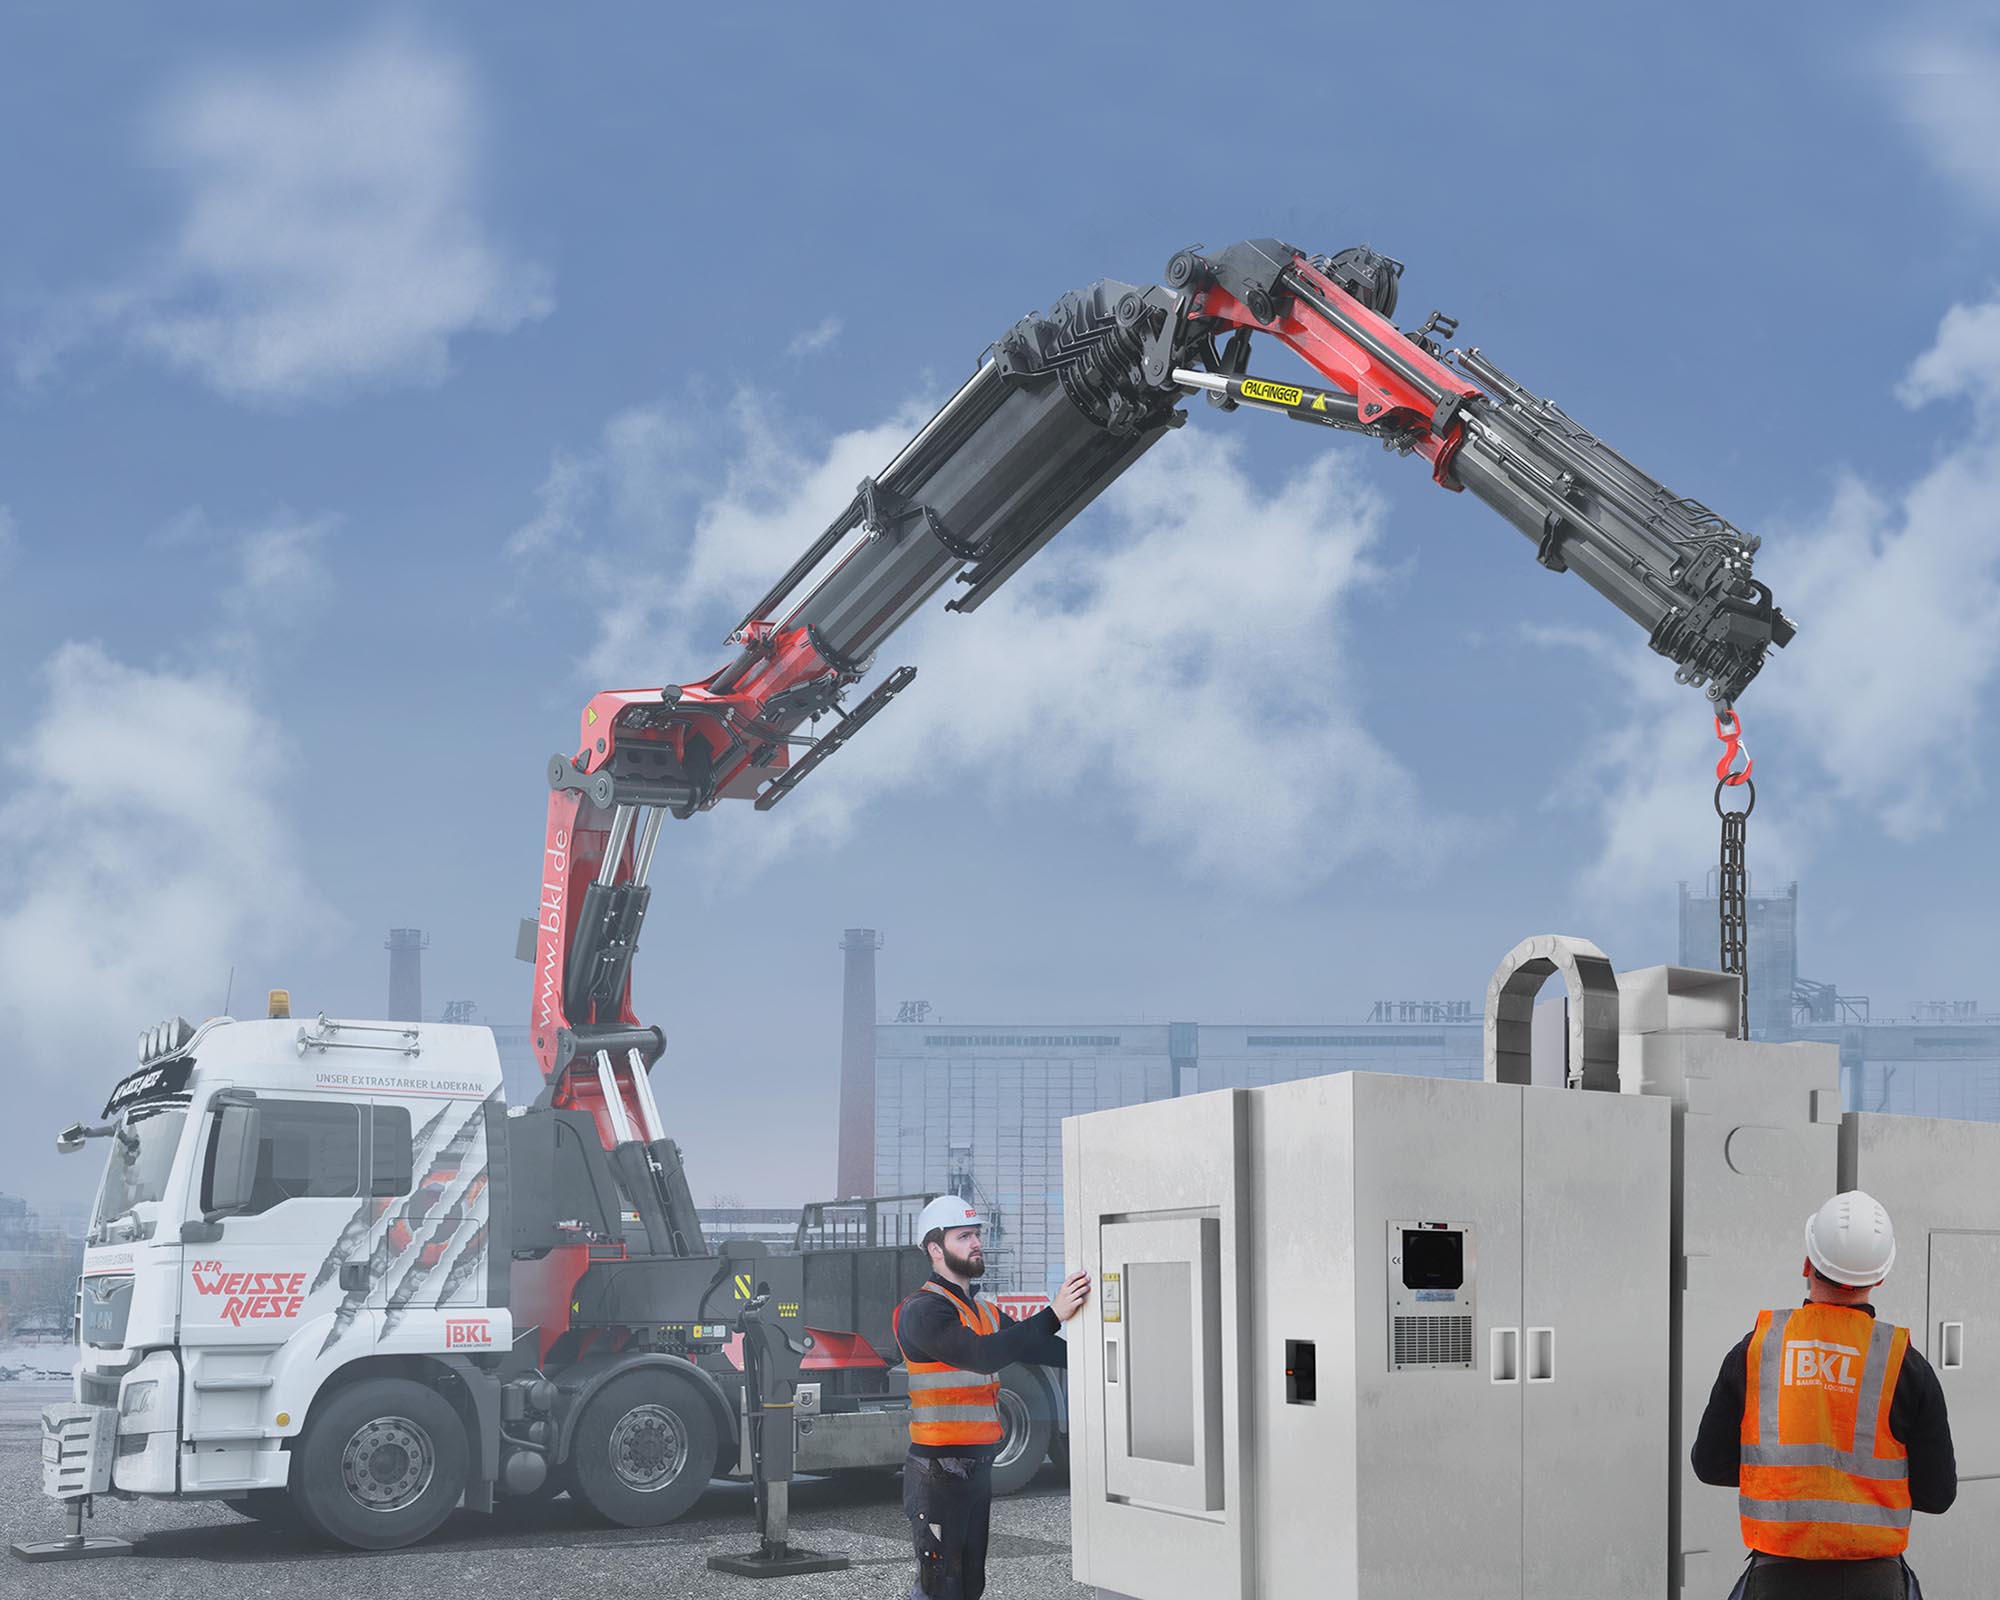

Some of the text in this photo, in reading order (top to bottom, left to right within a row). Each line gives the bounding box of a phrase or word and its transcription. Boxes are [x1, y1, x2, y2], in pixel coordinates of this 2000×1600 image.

[1244, 381, 1299, 403] PALFINGER
[539, 829, 568, 1028] www.bkl.de
[316, 1073, 349, 1085] UNSER
[191, 1260, 222, 1276] DER
[191, 1273, 306, 1295] WEISSE
[220, 1296, 305, 1327] RIESE
[452, 1325, 492, 1343] BKL
[1796, 1350, 1857, 1386] BKL
